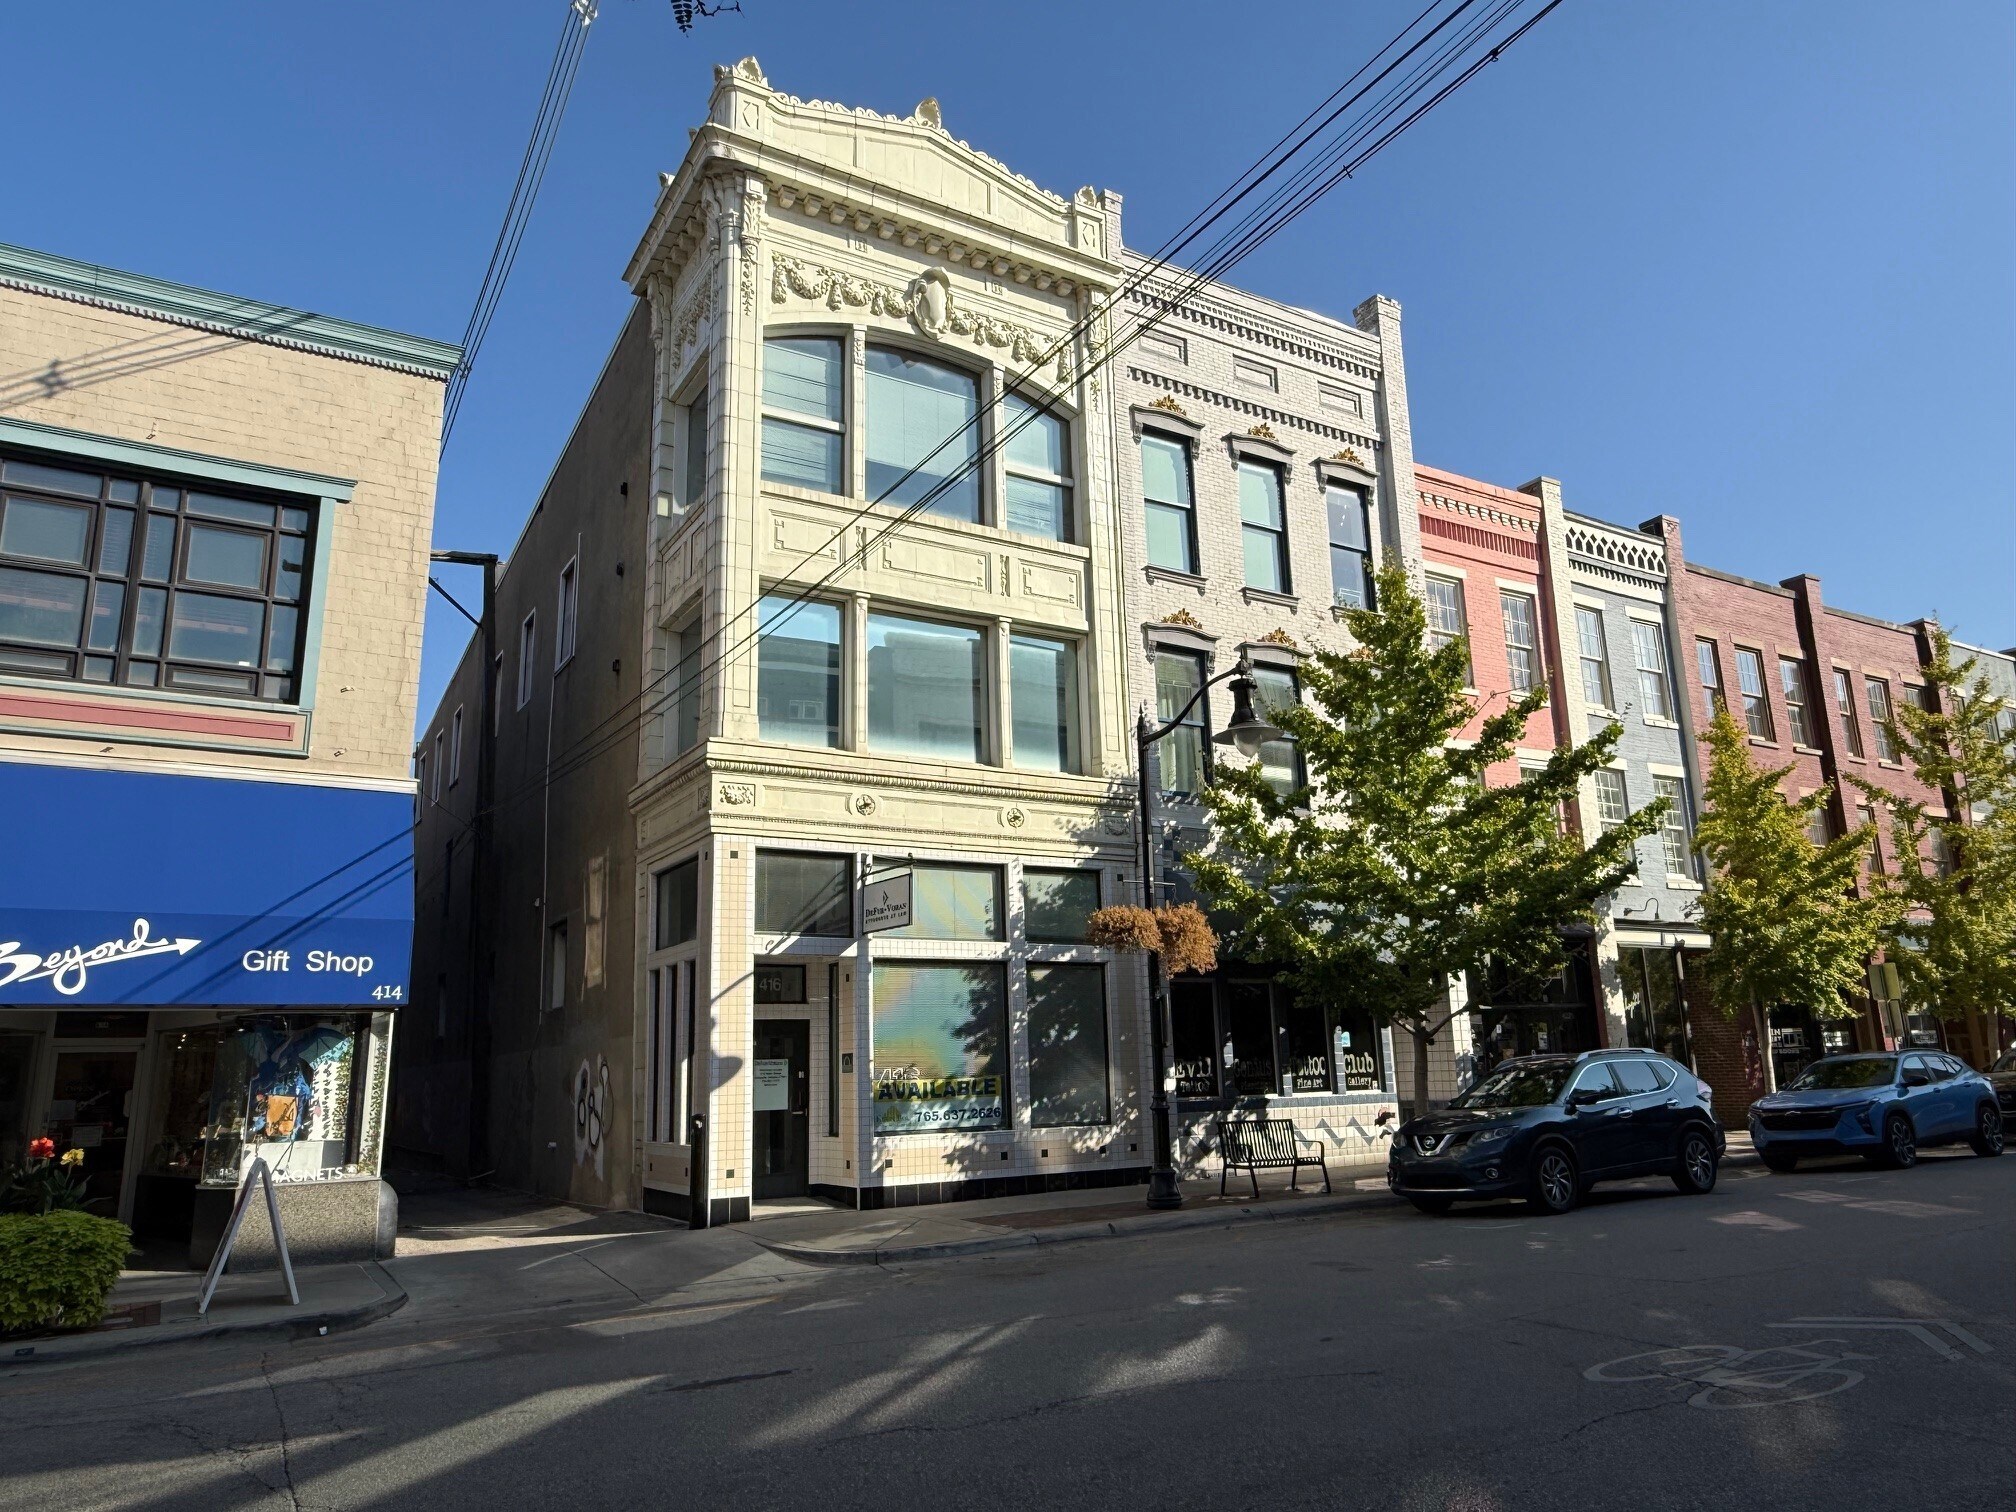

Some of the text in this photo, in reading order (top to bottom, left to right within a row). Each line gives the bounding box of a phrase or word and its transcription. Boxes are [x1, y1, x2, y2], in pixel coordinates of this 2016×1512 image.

[0, 918, 168, 995] Beyond
[242, 950, 373, 977] Gift Shop
[372, 985, 403, 1001] 414
[759, 977, 782, 991] 416
[1175, 1056, 1213, 1079] Evil
[1344, 1051, 1375, 1075] Club
[878, 1077, 997, 1100] AVAILABLE
